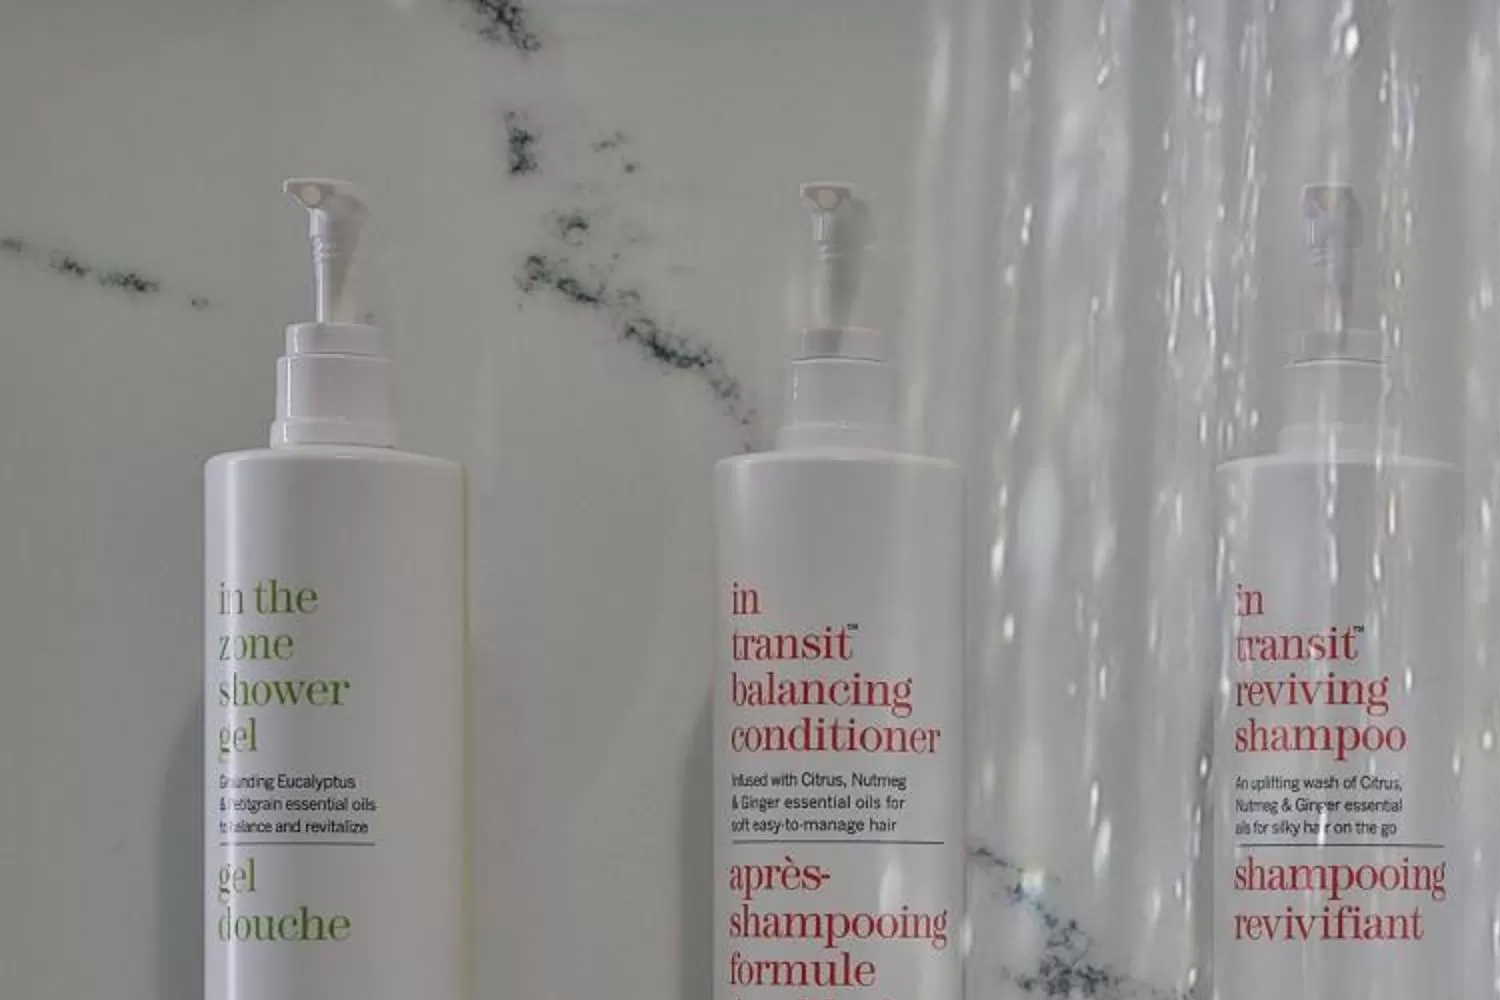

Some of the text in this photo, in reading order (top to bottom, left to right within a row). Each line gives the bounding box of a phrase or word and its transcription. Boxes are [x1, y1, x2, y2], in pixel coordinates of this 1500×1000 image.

[218, 579, 319, 615] in the
[731, 582, 761, 615] in
[1236, 583, 1265, 617] in
[218, 632, 294, 661] zone
[218, 672, 351, 706] shower
[731, 671, 913, 717] balancing
[1236, 672, 1390, 716] reviving
[218, 717, 257, 762] gel
[731, 717, 941, 753] conditioner
[1234, 717, 1407, 761] shampoo
[277, 774, 357, 791] Eucalyptus
[771, 773, 798, 787] with
[801, 772, 847, 789] Citrus,
[851, 772, 907, 790] Nutmeg
[1303, 776, 1339, 789] wash
[1343, 776, 1358, 789] of
[285, 797, 348, 811] essential
[351, 797, 376, 811] oils
[741, 795, 781, 812] Ginger
[783, 795, 851, 809] essential
[855, 795, 881, 809] oils
[886, 795, 906, 809] for
[1235, 799, 1279, 815] Nutmeg
[1281, 798, 1292, 812] &
[1343, 799, 1403, 812] essential
[275, 819, 301, 833] and
[305, 819, 369, 833] revitalize
[731, 818, 749, 832] soft
[869, 818, 897, 832] hair
[1253, 820, 1270, 835] for
[1271, 820, 1300, 837] silky
[1303, 820, 1331, 835] har
[1333, 824, 1353, 835] on
[1355, 822, 1378, 835] the
[1380, 823, 1398, 838] go
[218, 858, 257, 904] gel
[729, 855, 831, 900] après-
[1234, 856, 1447, 900] shampooing
[218, 905, 351, 941] douche
[729, 904, 948, 950] shampooing
[1234, 906, 1424, 941] revivifiant
[728, 952, 876, 987] formule
